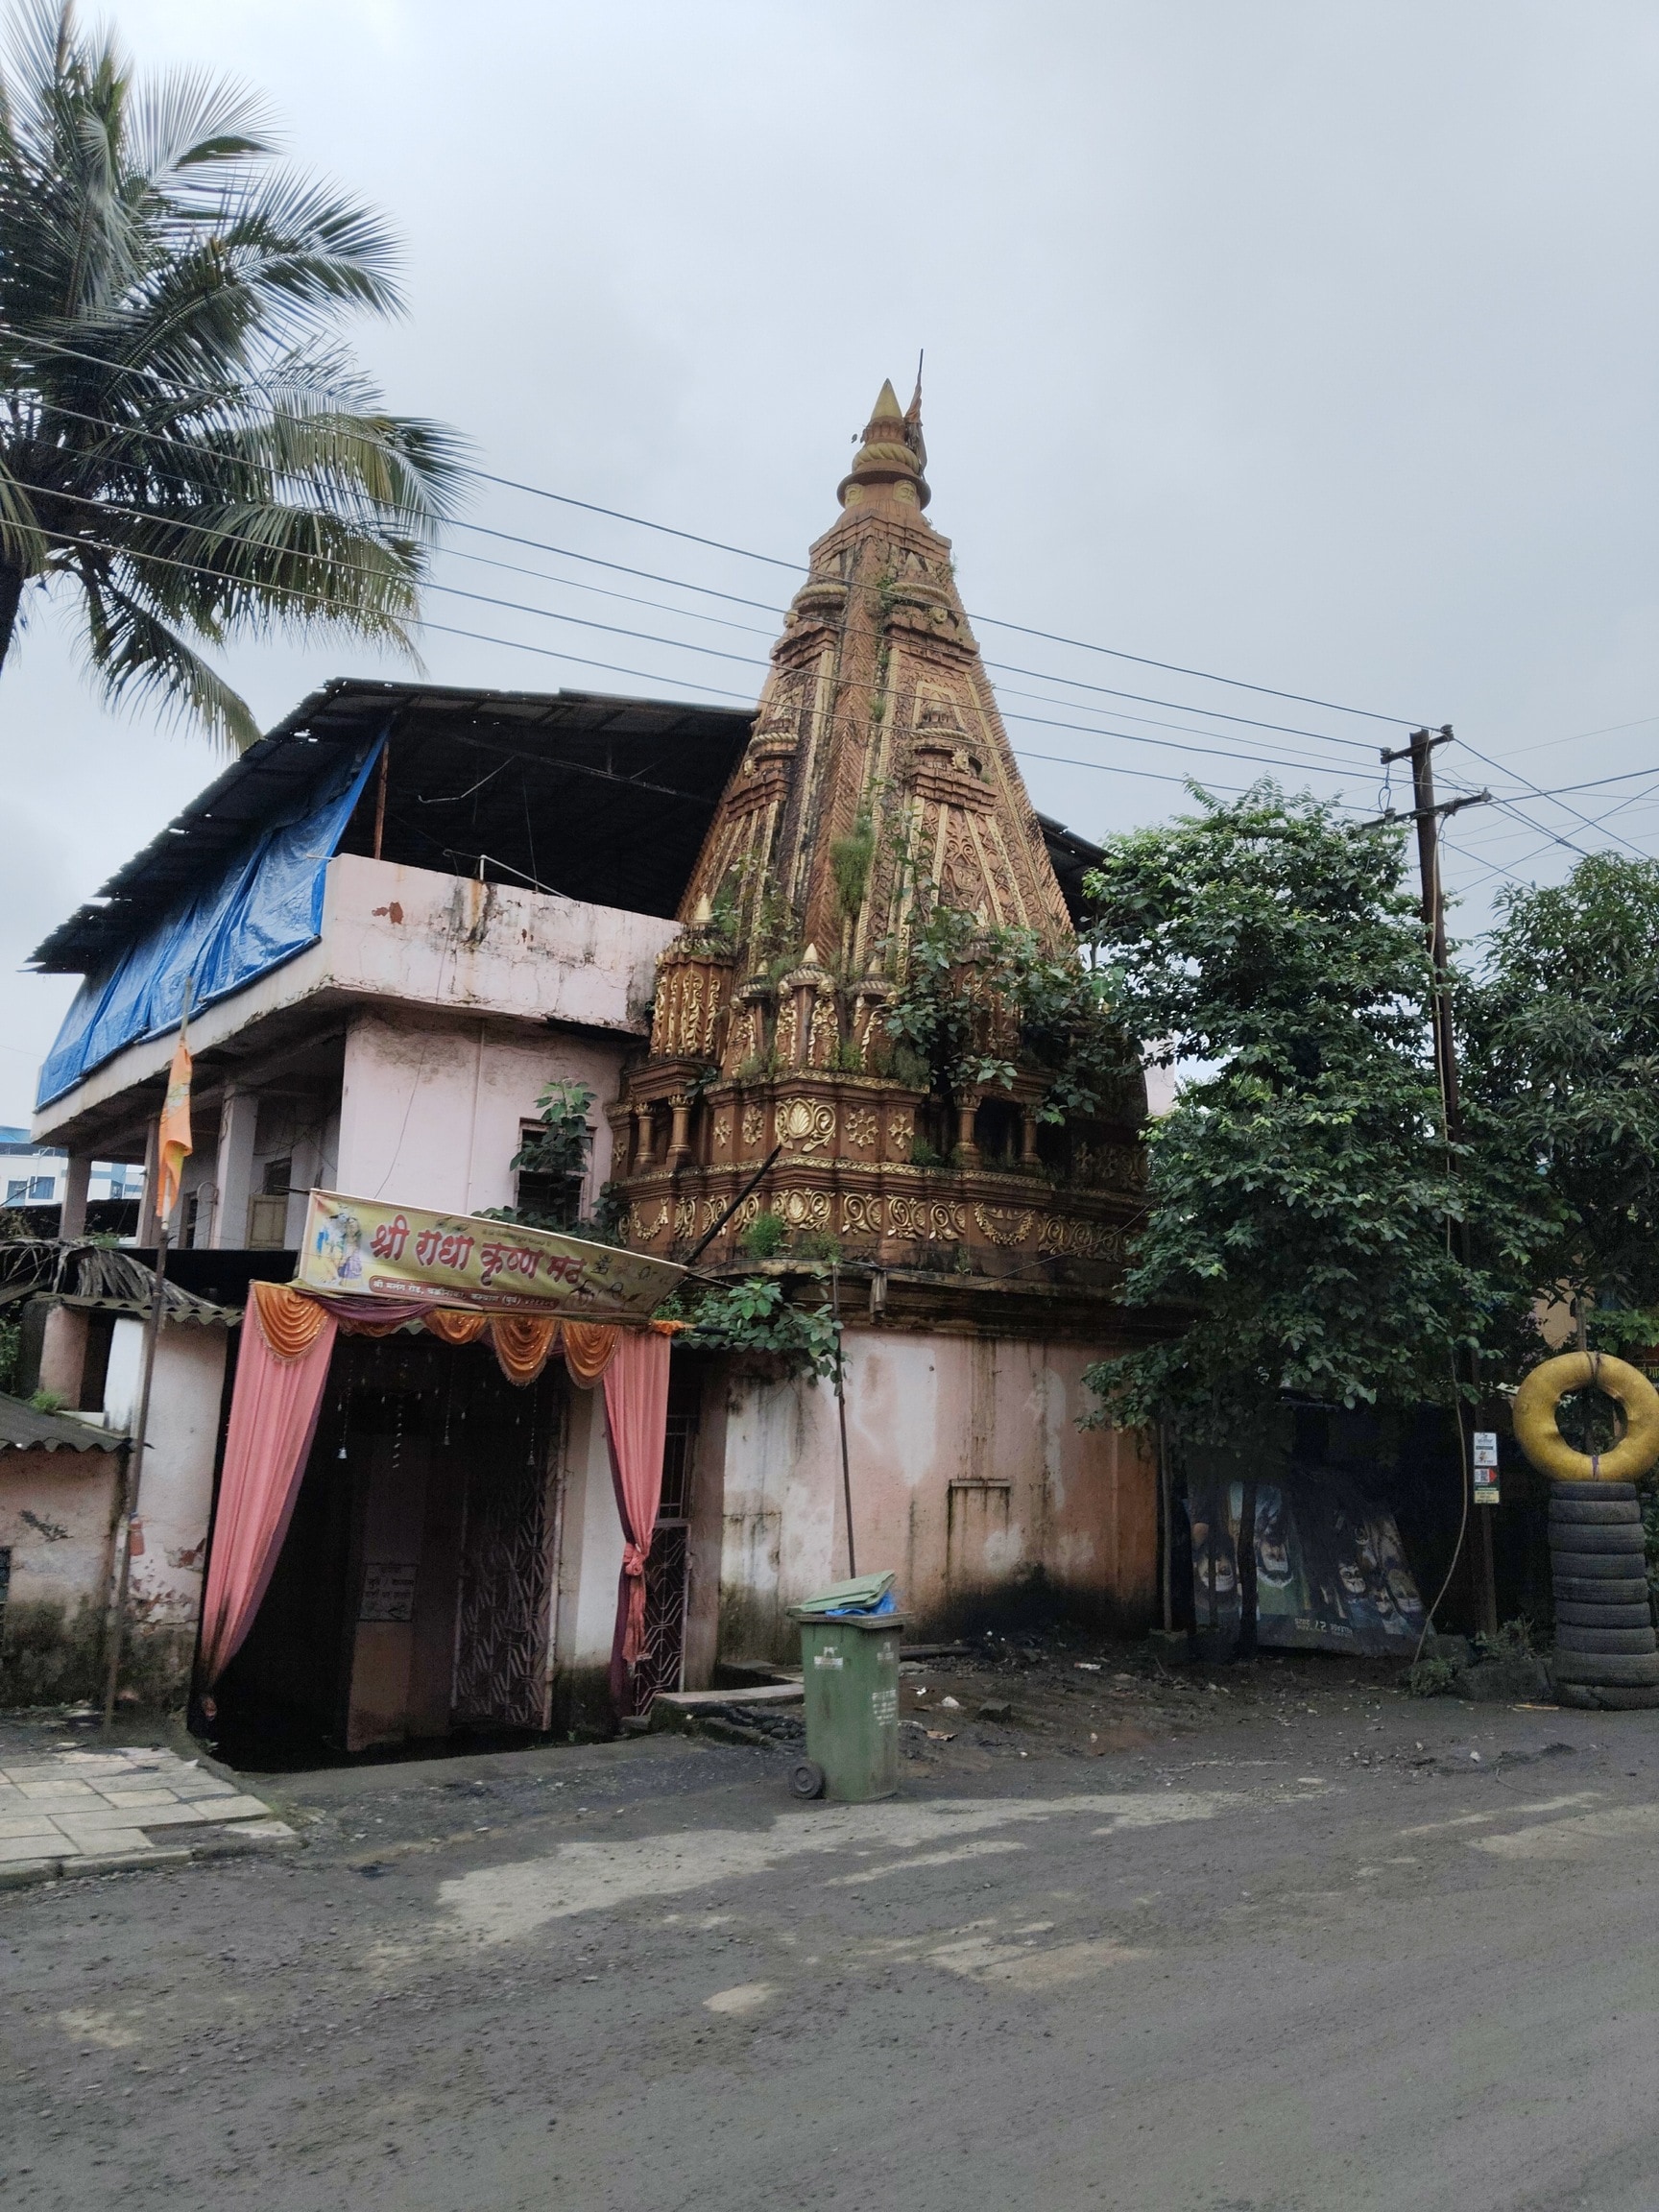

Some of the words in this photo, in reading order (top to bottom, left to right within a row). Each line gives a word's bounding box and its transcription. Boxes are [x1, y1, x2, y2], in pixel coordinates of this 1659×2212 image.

[370, 1214, 411, 1262] श्री
[416, 1229, 475, 1271] राधा
[480, 1241, 545, 1286] कृष्ण
[546, 1255, 589, 1285] मठ
[373, 1279, 384, 1288] श्री
